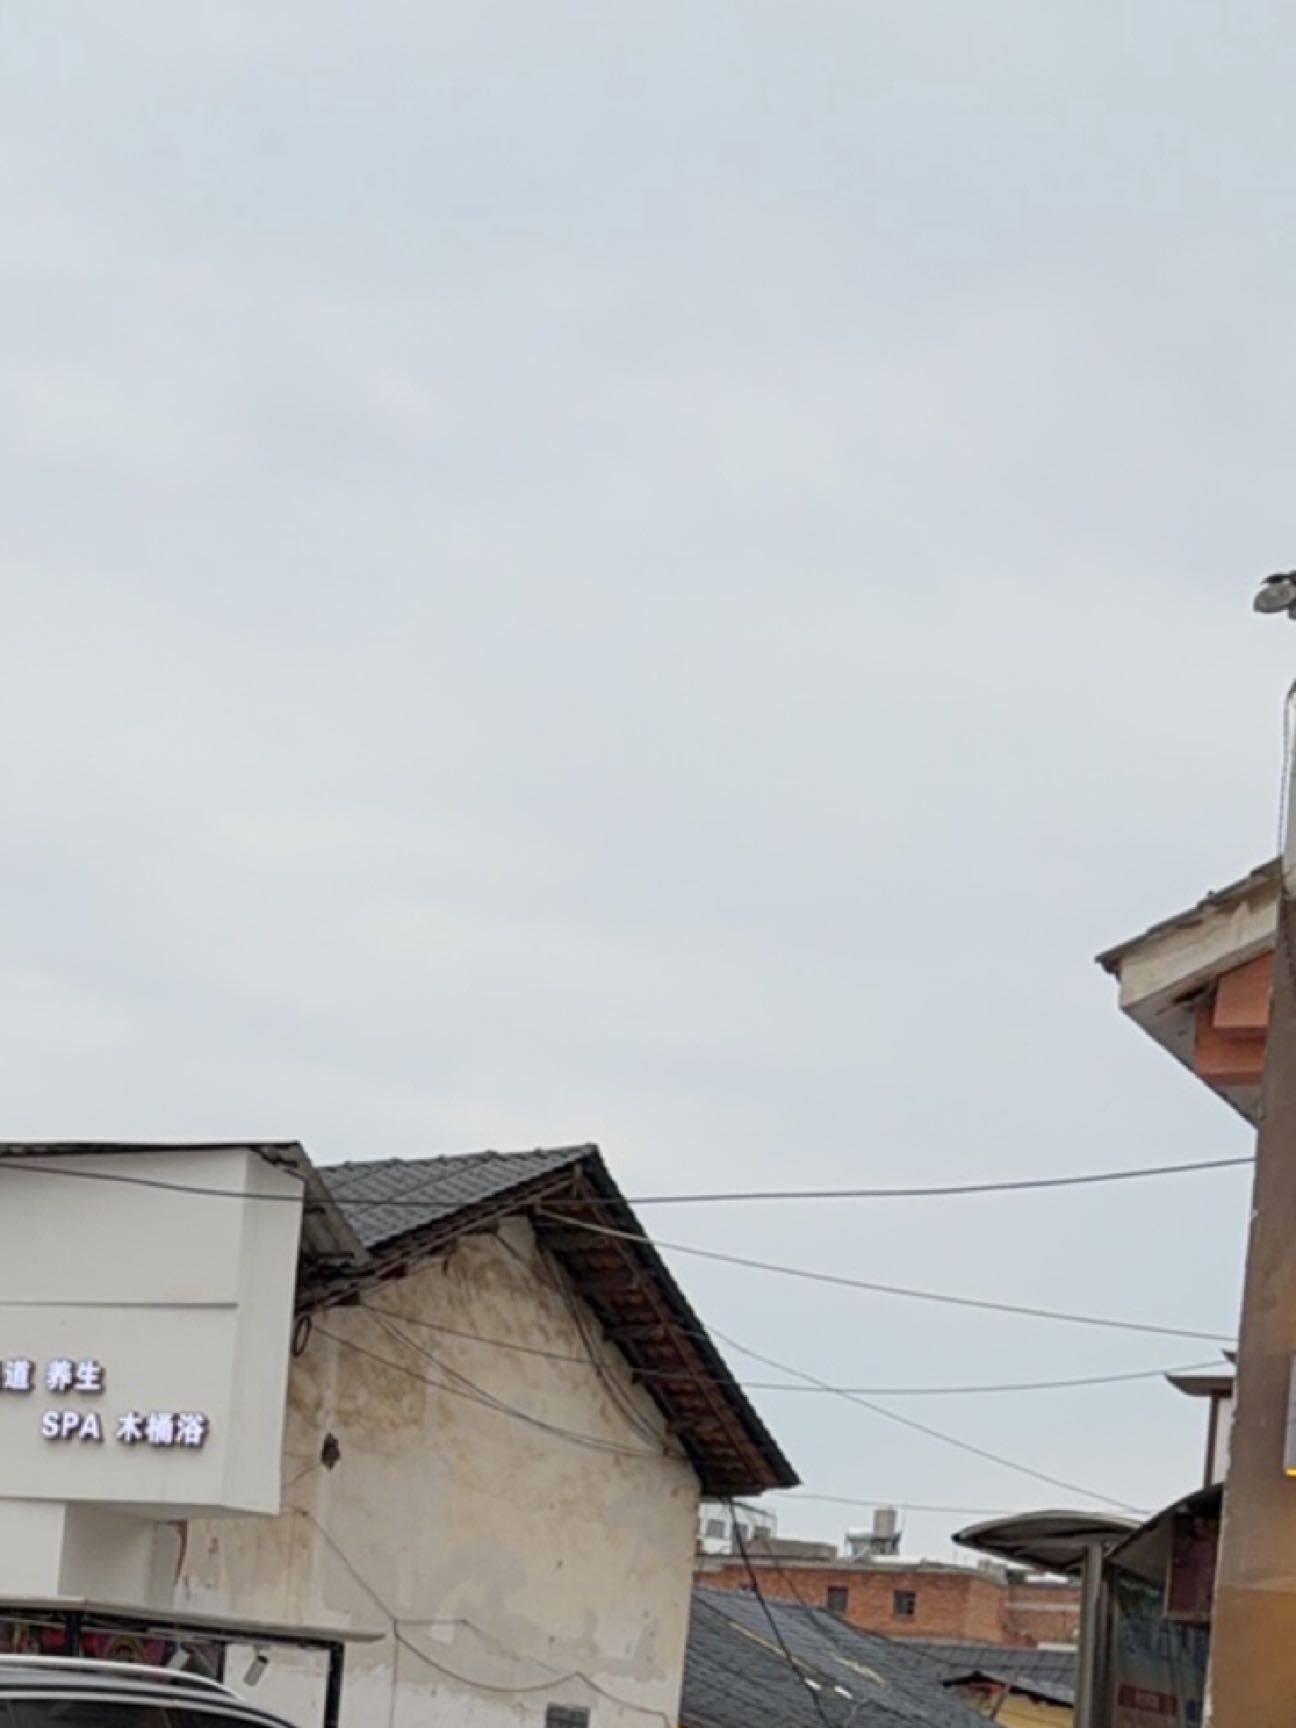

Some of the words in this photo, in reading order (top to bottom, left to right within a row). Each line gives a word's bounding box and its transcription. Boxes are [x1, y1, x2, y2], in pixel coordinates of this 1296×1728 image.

[46, 1359, 104, 1392] 养生
[40, 1410, 102, 1441] SPA
[115, 1410, 206, 1447] 木桶浴
